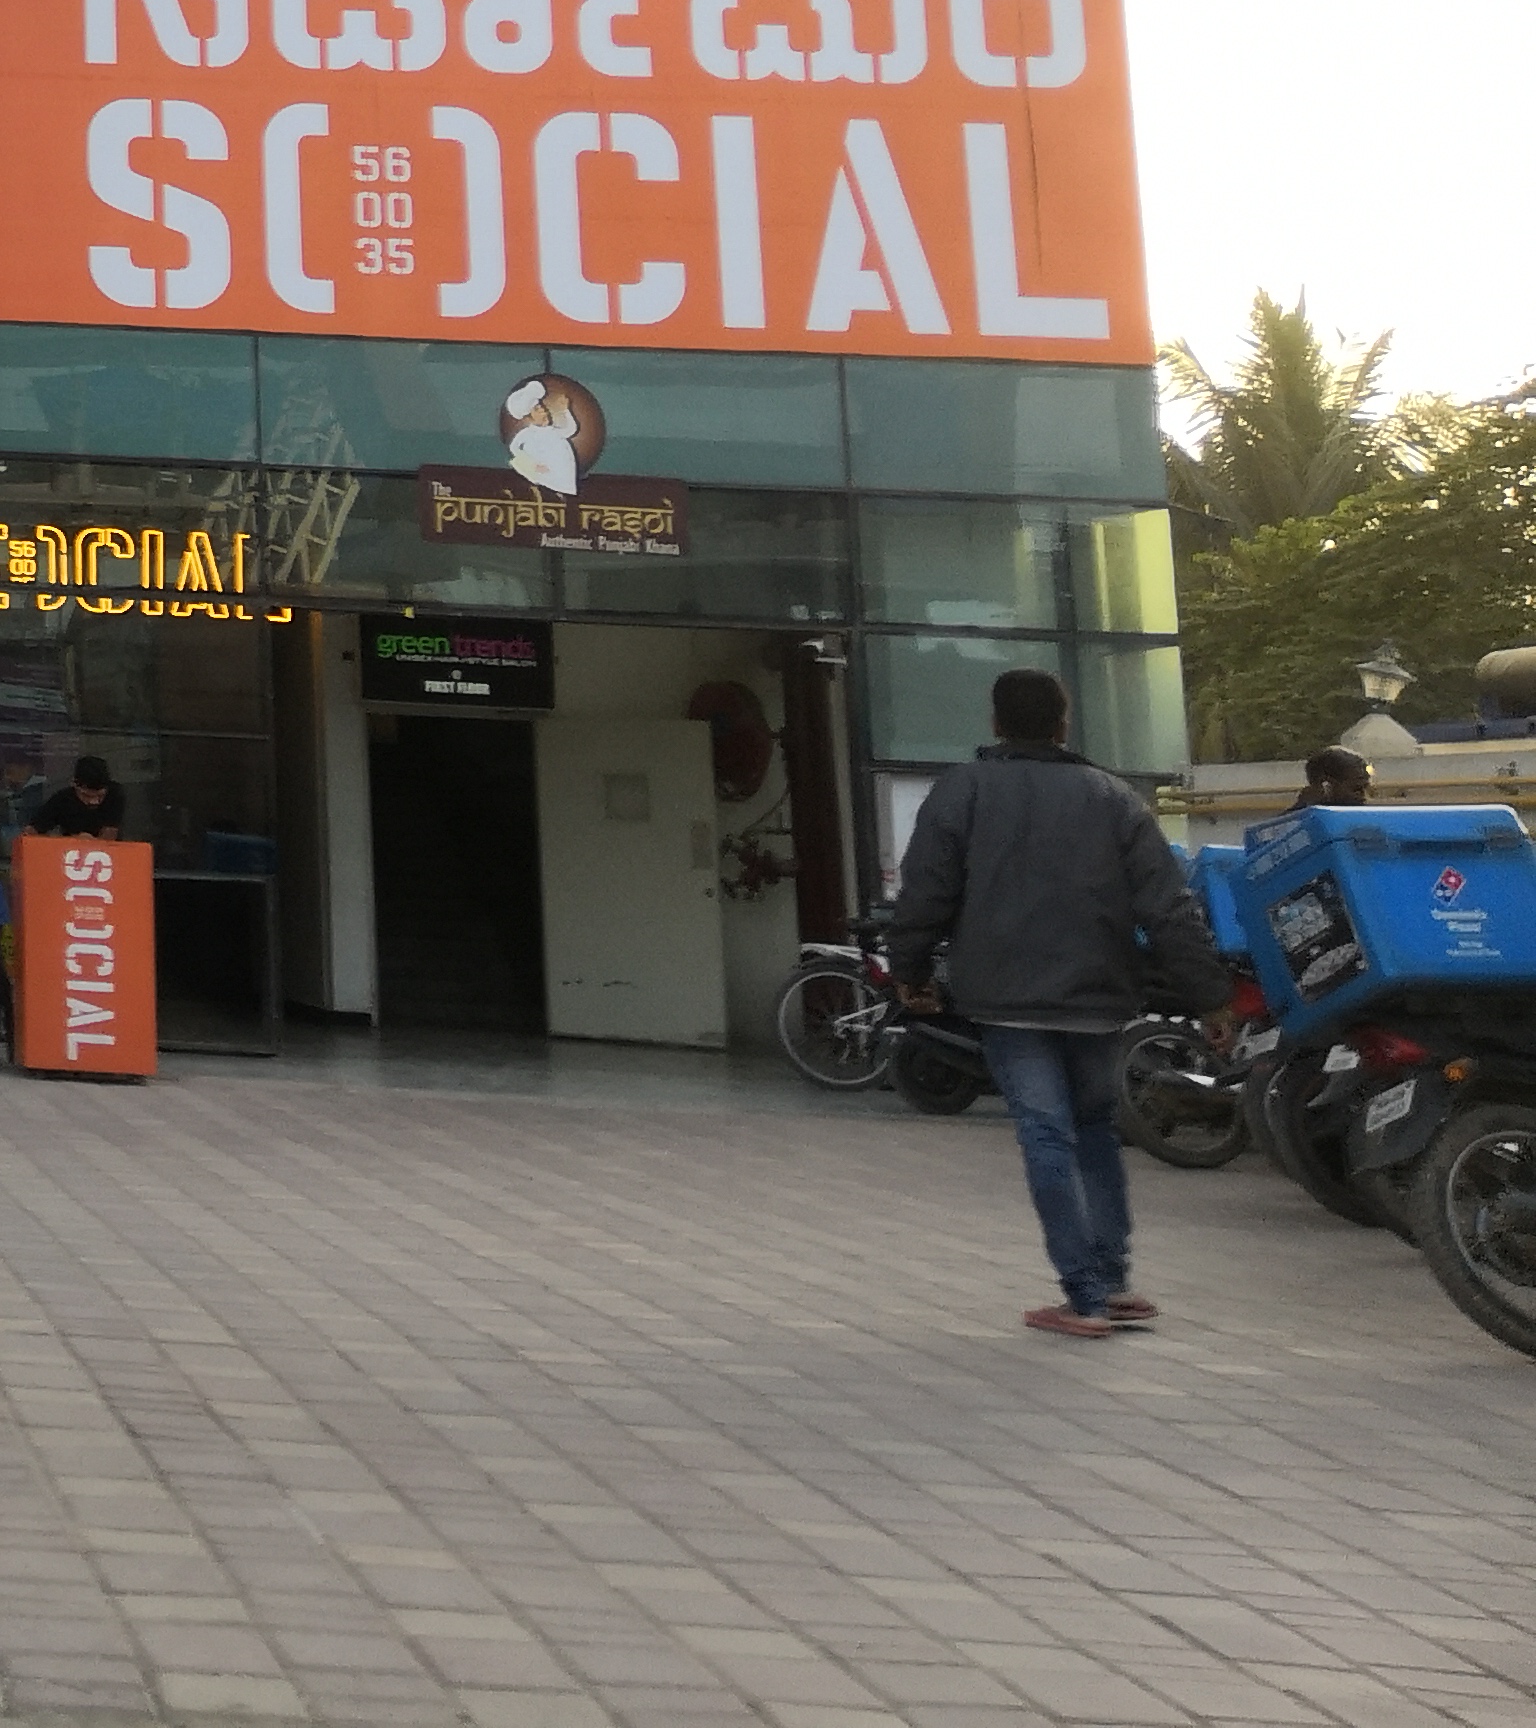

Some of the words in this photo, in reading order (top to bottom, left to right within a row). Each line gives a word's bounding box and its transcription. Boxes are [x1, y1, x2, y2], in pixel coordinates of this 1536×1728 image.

[351, 144, 414, 186] 56
[354, 190, 414, 232] 00
[354, 235, 417, 278] 35
[431, 480, 453, 498] The
[432, 485, 567, 538] punjabi
[578, 497, 675, 539] rasoi
[377, 634, 451, 659] green
